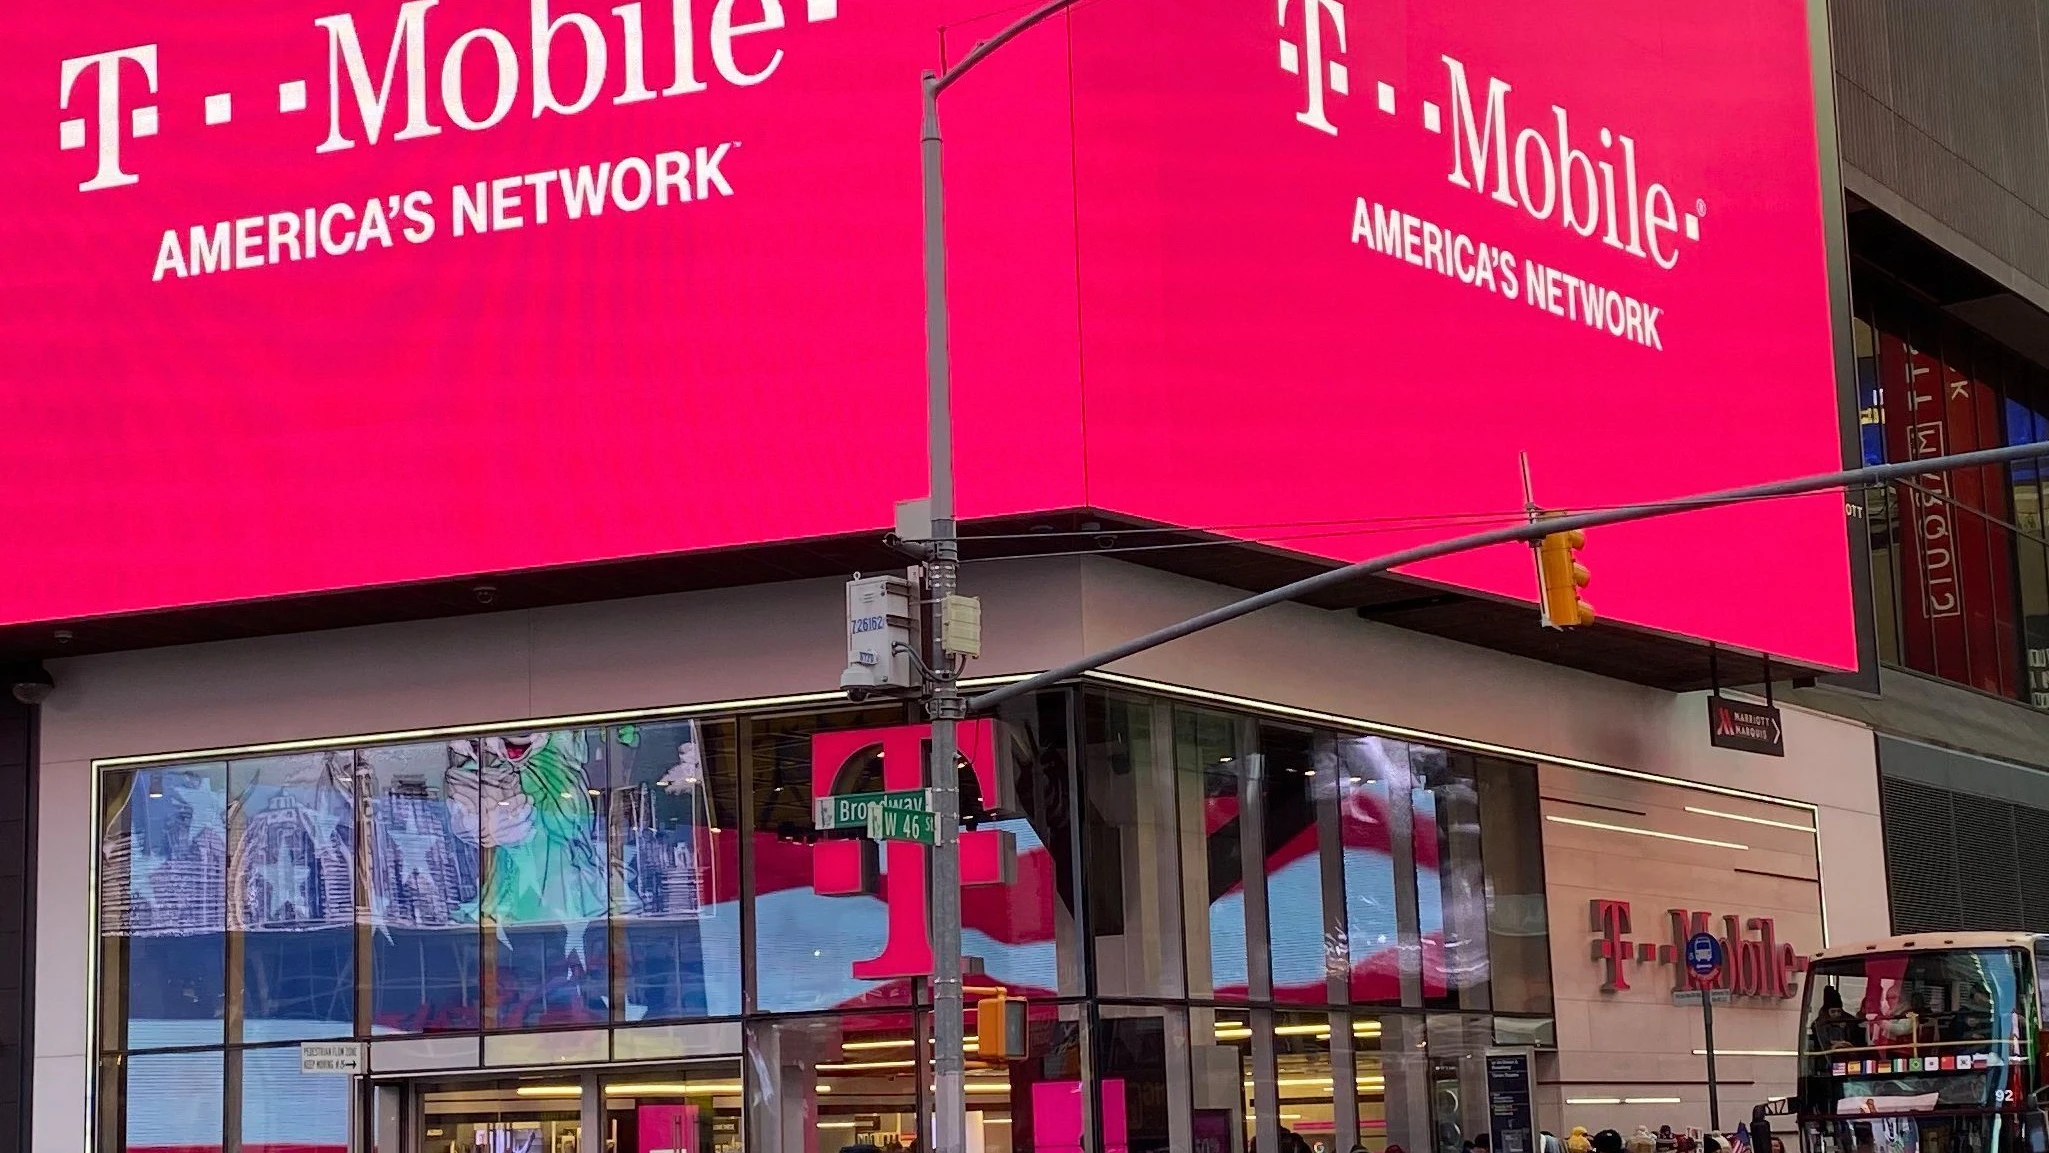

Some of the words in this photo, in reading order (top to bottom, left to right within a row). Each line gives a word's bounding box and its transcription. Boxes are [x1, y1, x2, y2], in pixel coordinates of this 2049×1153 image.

[453, 143, 733, 236] NETWORK
[1526, 259, 1663, 350] NETWORK
[851, 616, 883, 635] 726162
[884, 811, 897, 837] W
[902, 814, 920, 839] 46
[1995, 1089, 2014, 1102] 92
